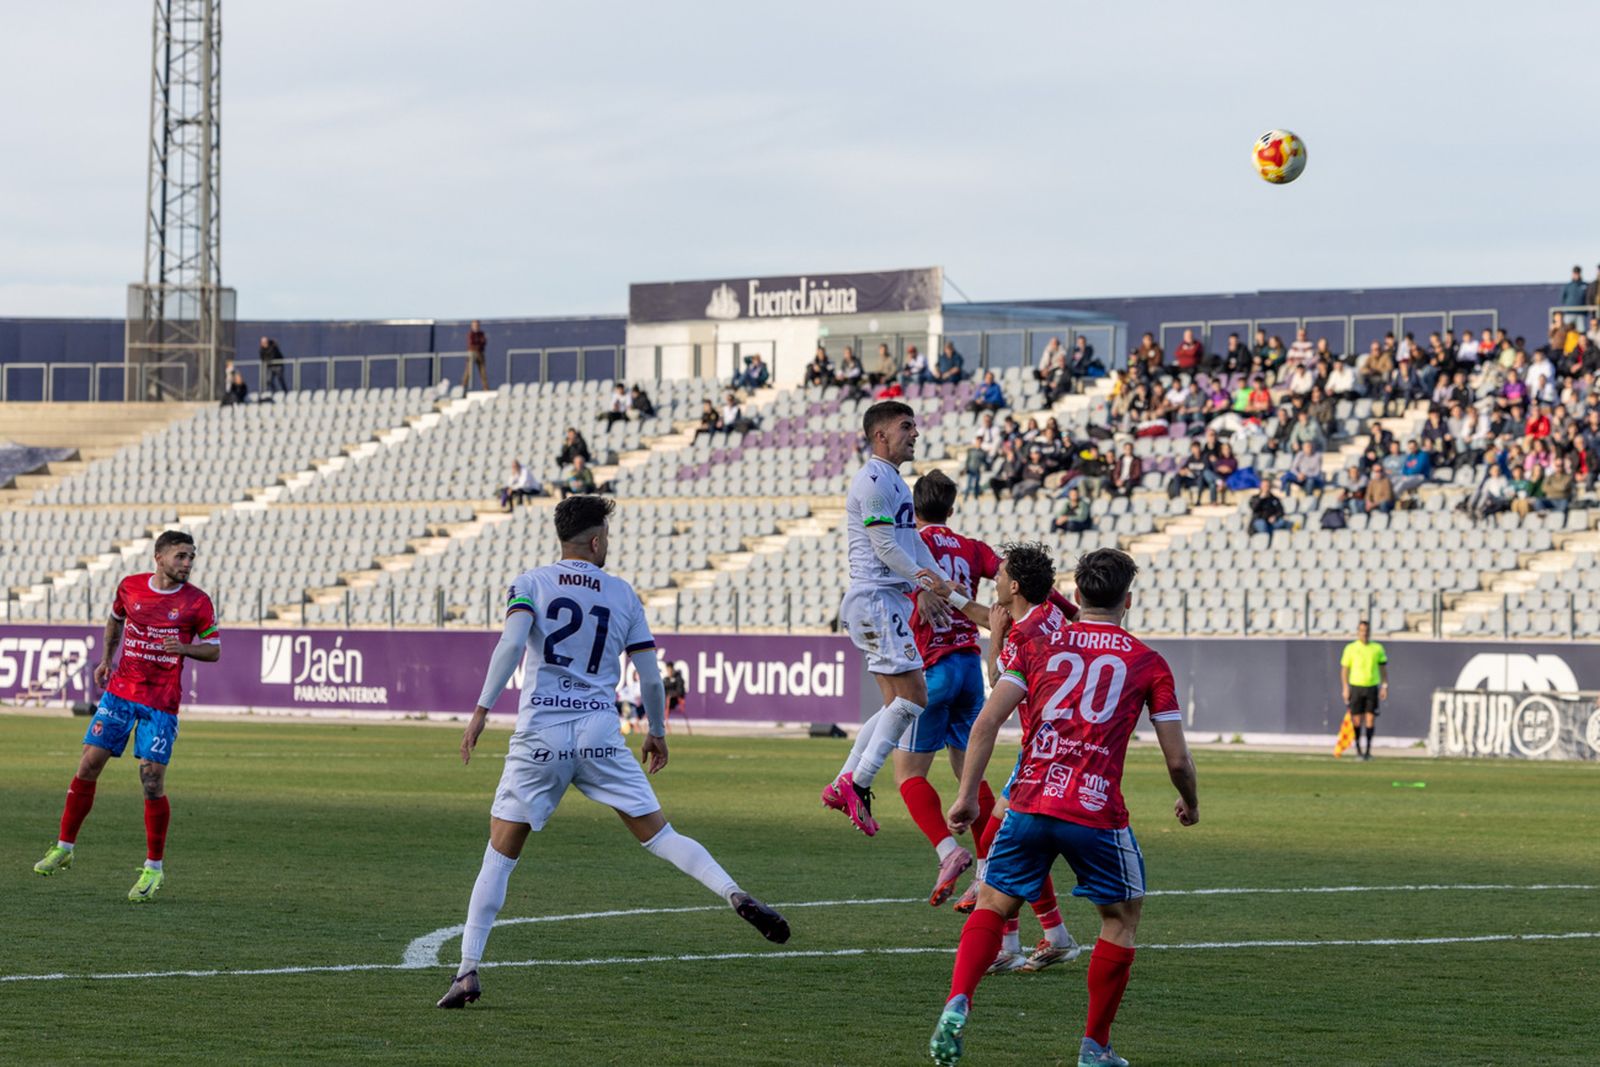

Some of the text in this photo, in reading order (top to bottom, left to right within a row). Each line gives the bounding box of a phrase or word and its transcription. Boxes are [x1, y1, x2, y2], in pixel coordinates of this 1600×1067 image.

[748, 277, 858, 318] FuenteLiviana
[558, 573, 601, 592] MOHA
[543, 597, 611, 675] 21
[892, 613, 909, 637] 2
[1050, 630, 1133, 652] P. TORRES
[294, 635, 362, 684] Jaén
[698, 650, 845, 704] Hyundai
[1041, 651, 1128, 724] 20
[294, 682, 388, 704] PARAÍSO INTERIOR
[530, 695, 610, 711] calderón
[150, 736, 167, 754] 22
